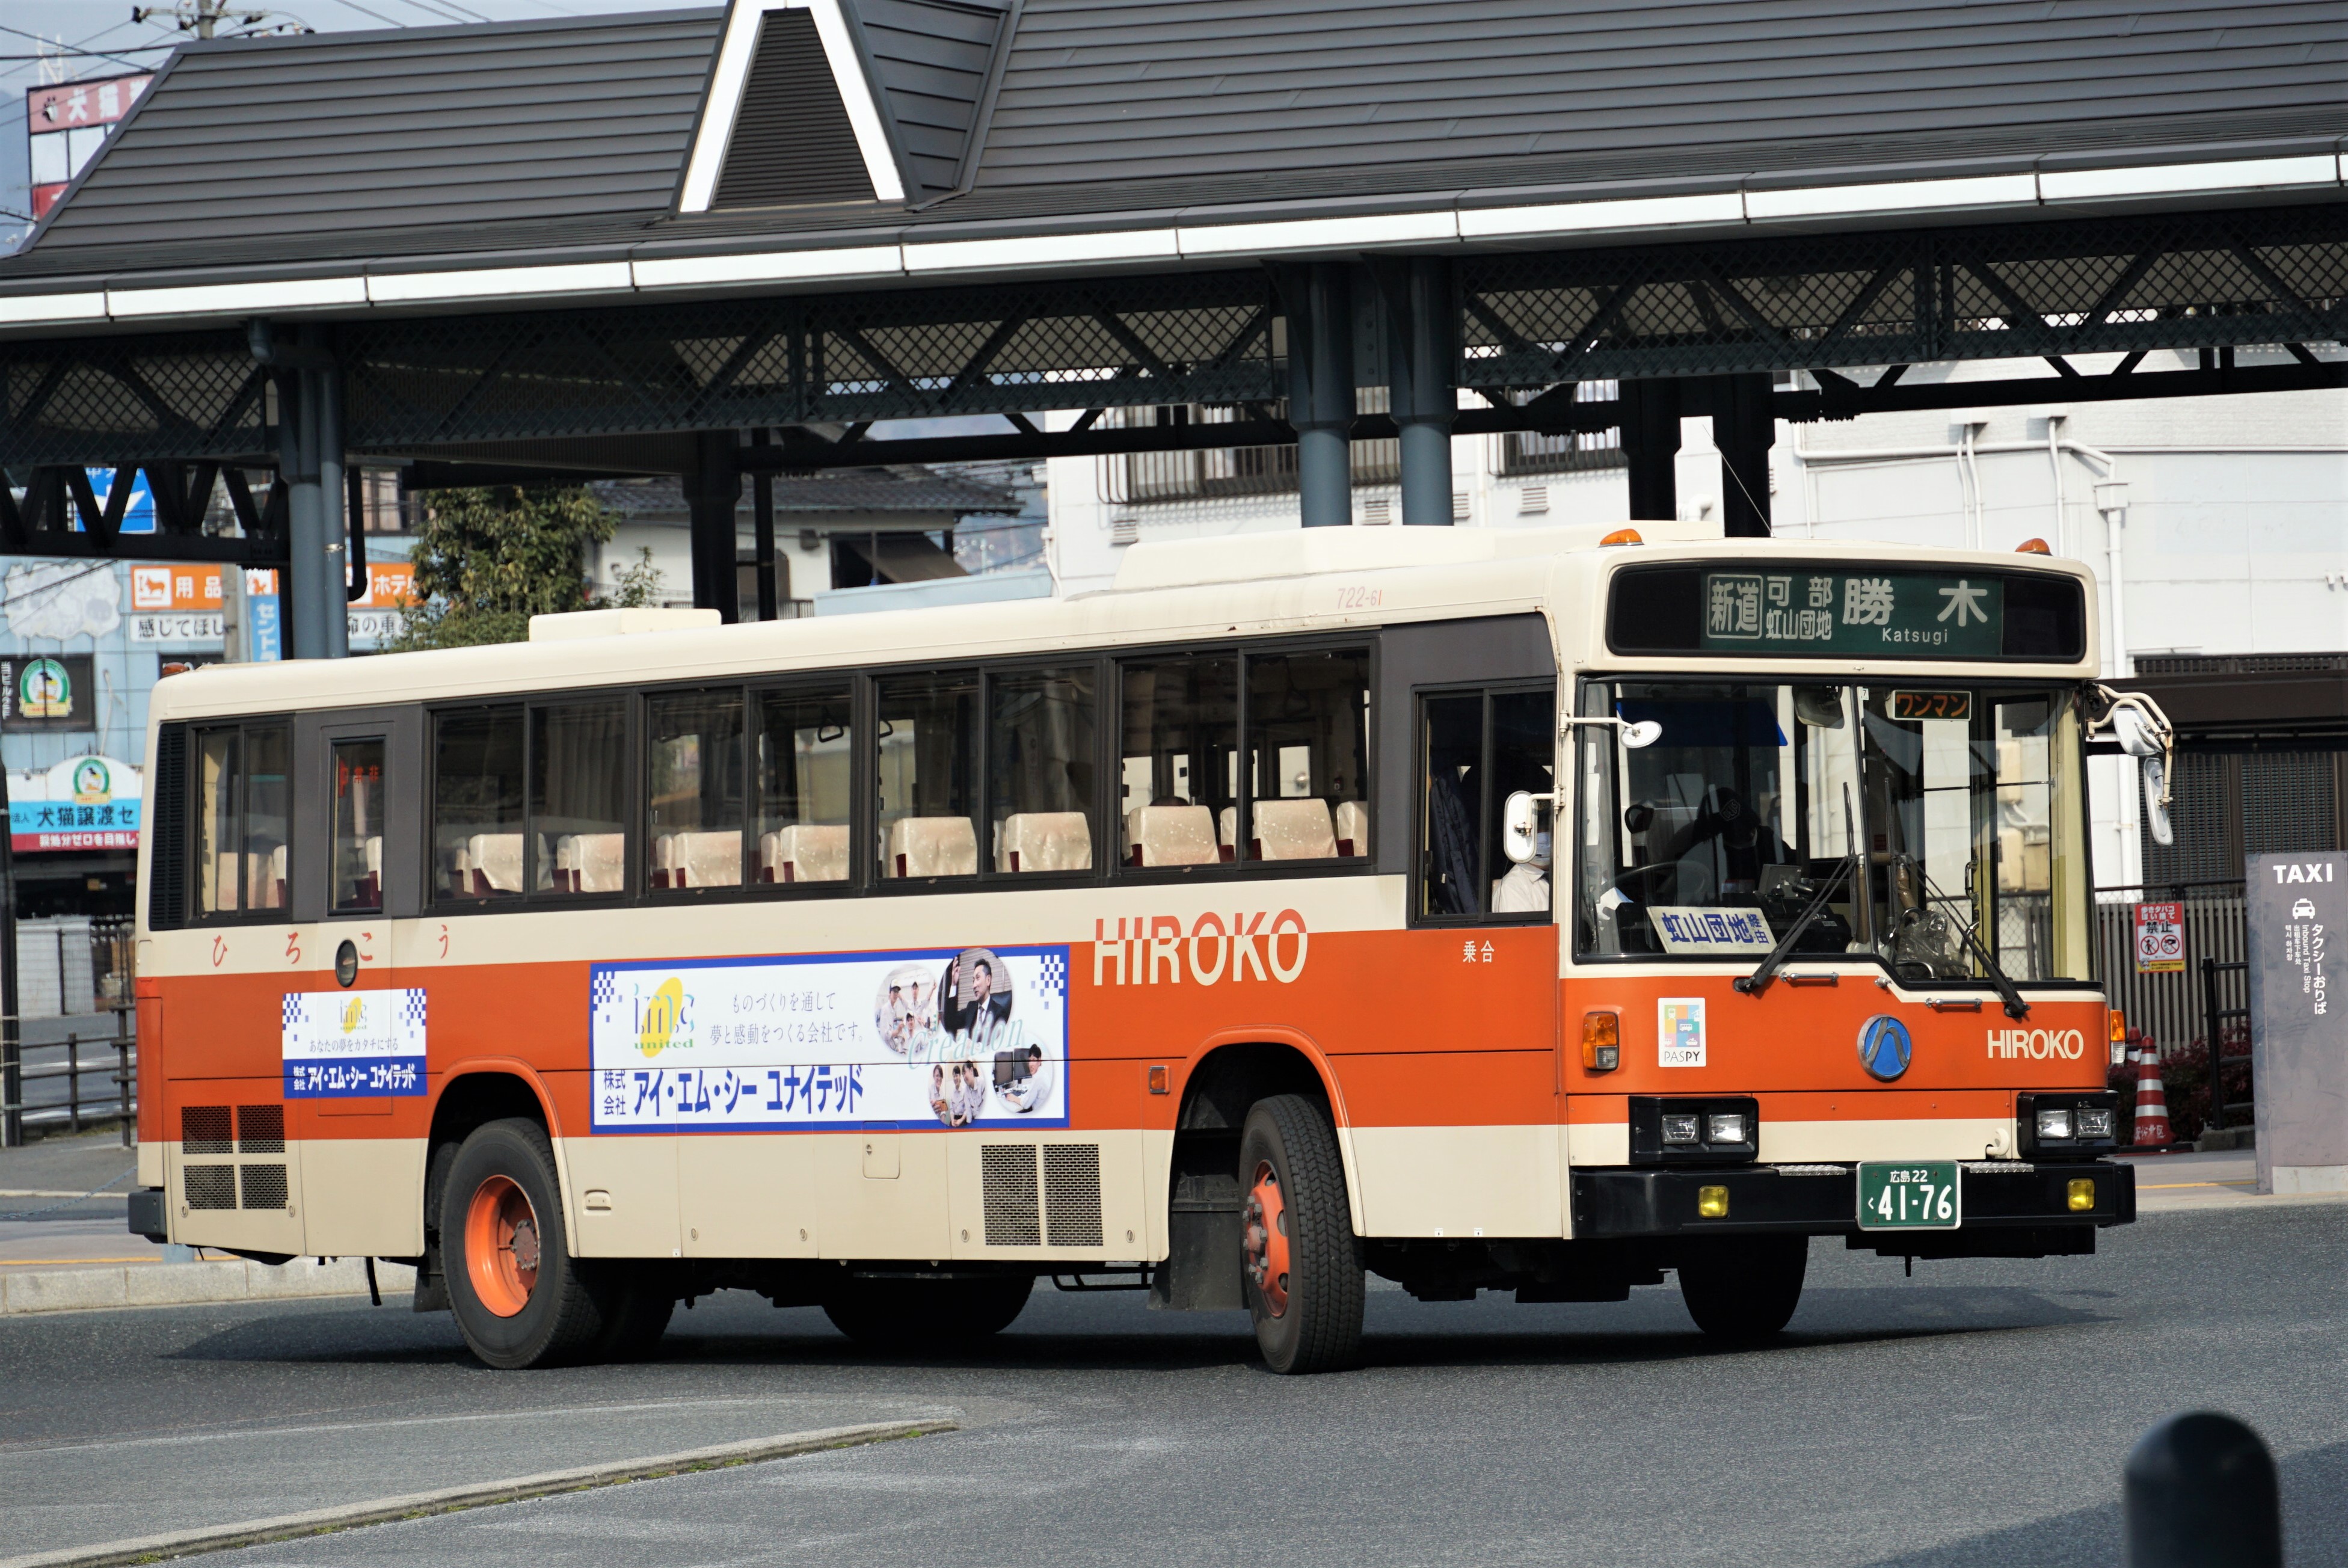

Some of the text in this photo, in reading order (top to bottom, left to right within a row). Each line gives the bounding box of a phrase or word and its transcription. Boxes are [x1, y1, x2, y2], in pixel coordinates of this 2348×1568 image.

[176, 576, 222, 599] 用品
[1338, 586, 1382, 609] 722-61
[1766, 576, 1833, 607] 可部
[1710, 580, 1760, 632] 新道
[1842, 577, 1988, 627] 勝木
[1765, 609, 1833, 641] 虹山団地
[1882, 627, 1948, 645] Katsugi
[1896, 693, 1968, 717] ワンマン
[39, 832, 139, 847] 殺処分ゼロを目指し
[2273, 863, 2333, 884] TAXI
[1661, 912, 1754, 944] 虹山団地
[1746, 913, 1770, 945] 経由
[2145, 920, 2174, 934] 禁止
[1093, 908, 1308, 986] HIROKO
[1463, 939, 1495, 964] 乗合
[2302, 924, 2310, 956] Inbound
[2311, 923, 2328, 1015] タクシーおりば
[2303, 975, 2311, 994] Stop
[732, 991, 837, 1013] ものづくりを通して
[634, 1038, 694, 1050] united
[710, 1021, 864, 1046] 夢と感動をつくる会社です。
[907, 1013, 1024, 1071] Creation
[1987, 1028, 2084, 1060] HIROKO
[309, 1038, 398, 1053] あなたの夢をカタチにする
[1664, 1051, 1700, 1062] PASPY
[294, 1078, 306, 1090] 会社
[603, 1069, 626, 1090] 株式
[603, 1095, 626, 1116] 会社
[1890, 1169, 1928, 1183] 広島 22
[1867, 1184, 1952, 1220] く 41-76
